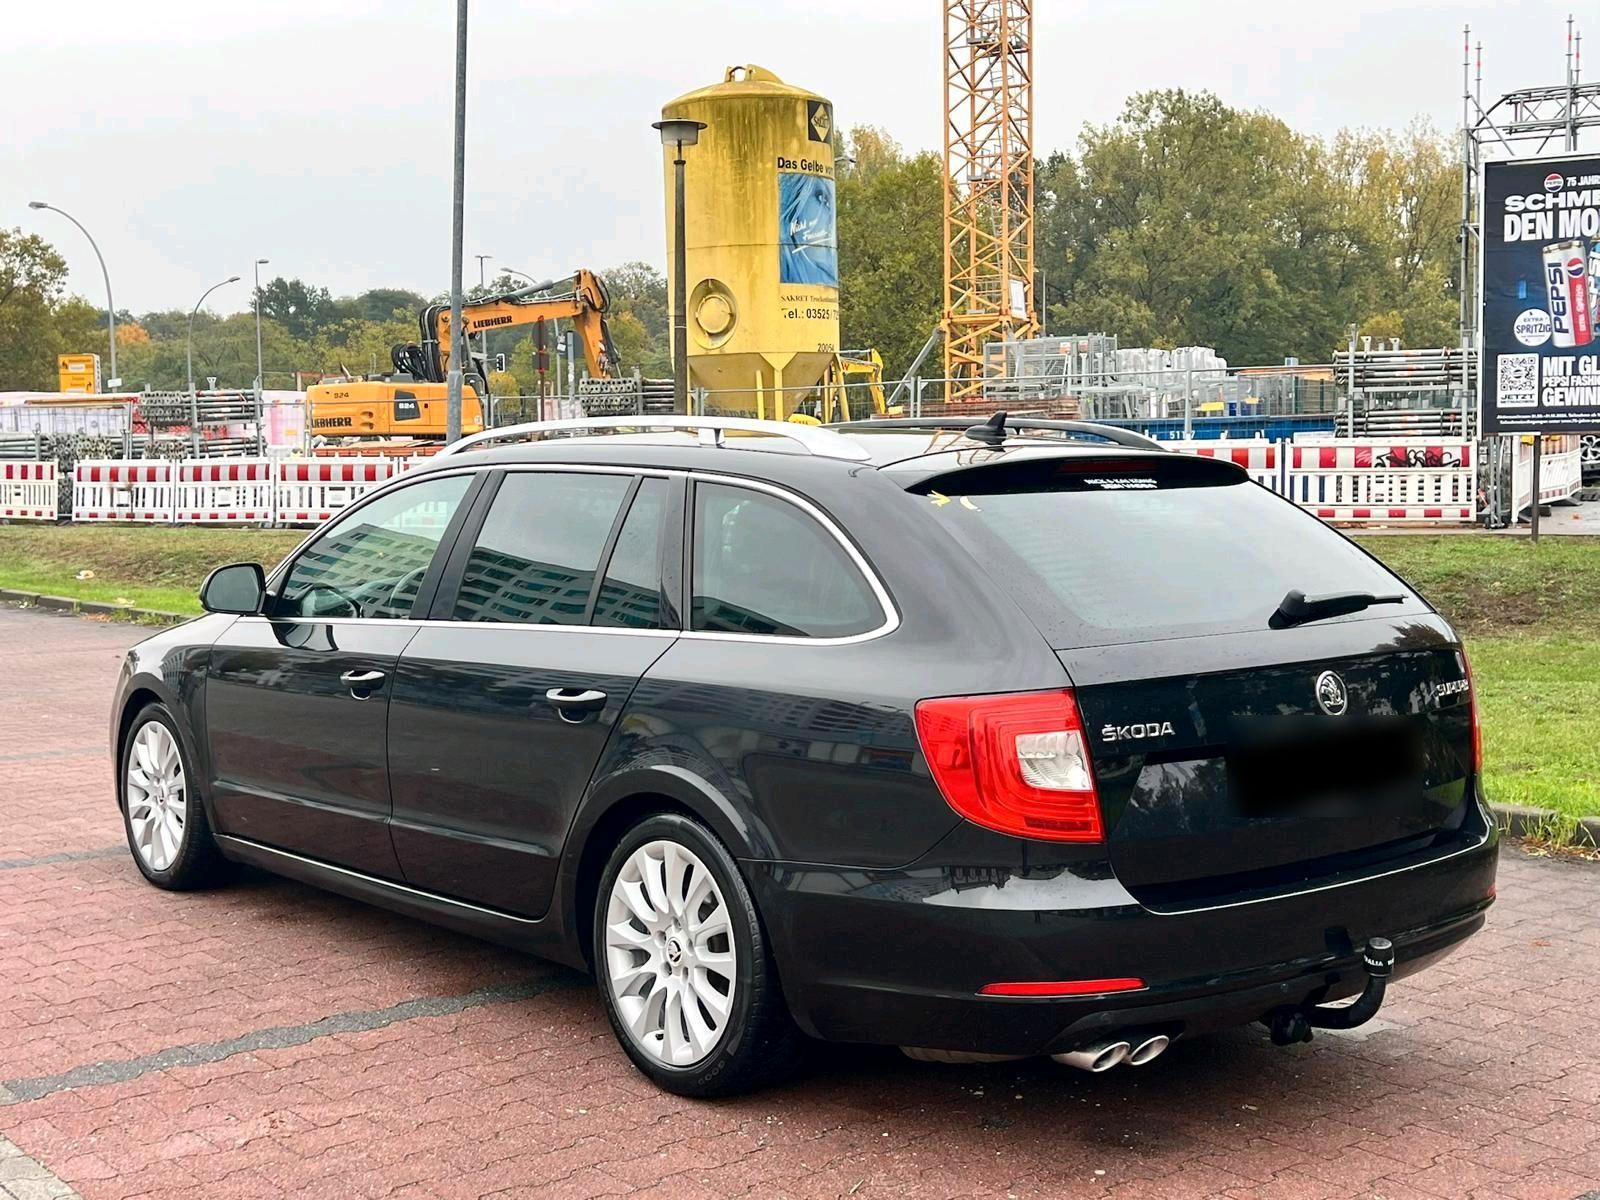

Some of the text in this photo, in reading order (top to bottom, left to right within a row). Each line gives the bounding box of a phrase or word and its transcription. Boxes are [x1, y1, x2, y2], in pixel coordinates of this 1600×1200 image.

[777, 156, 798, 170] Das
[800, 158, 824, 173] Gelbe
[1566, 176, 1577, 187] 75
[1503, 210, 1554, 243] DEN
[1547, 261, 1570, 335] PEPSI
[473, 316, 512, 329] LIEBHERR
[1515, 323, 1551, 335] SPRITZIG
[1542, 355, 1576, 377] MIT
[1542, 376, 1570, 388] PEPSI
[1101, 721, 1176, 742] ŠKODA
